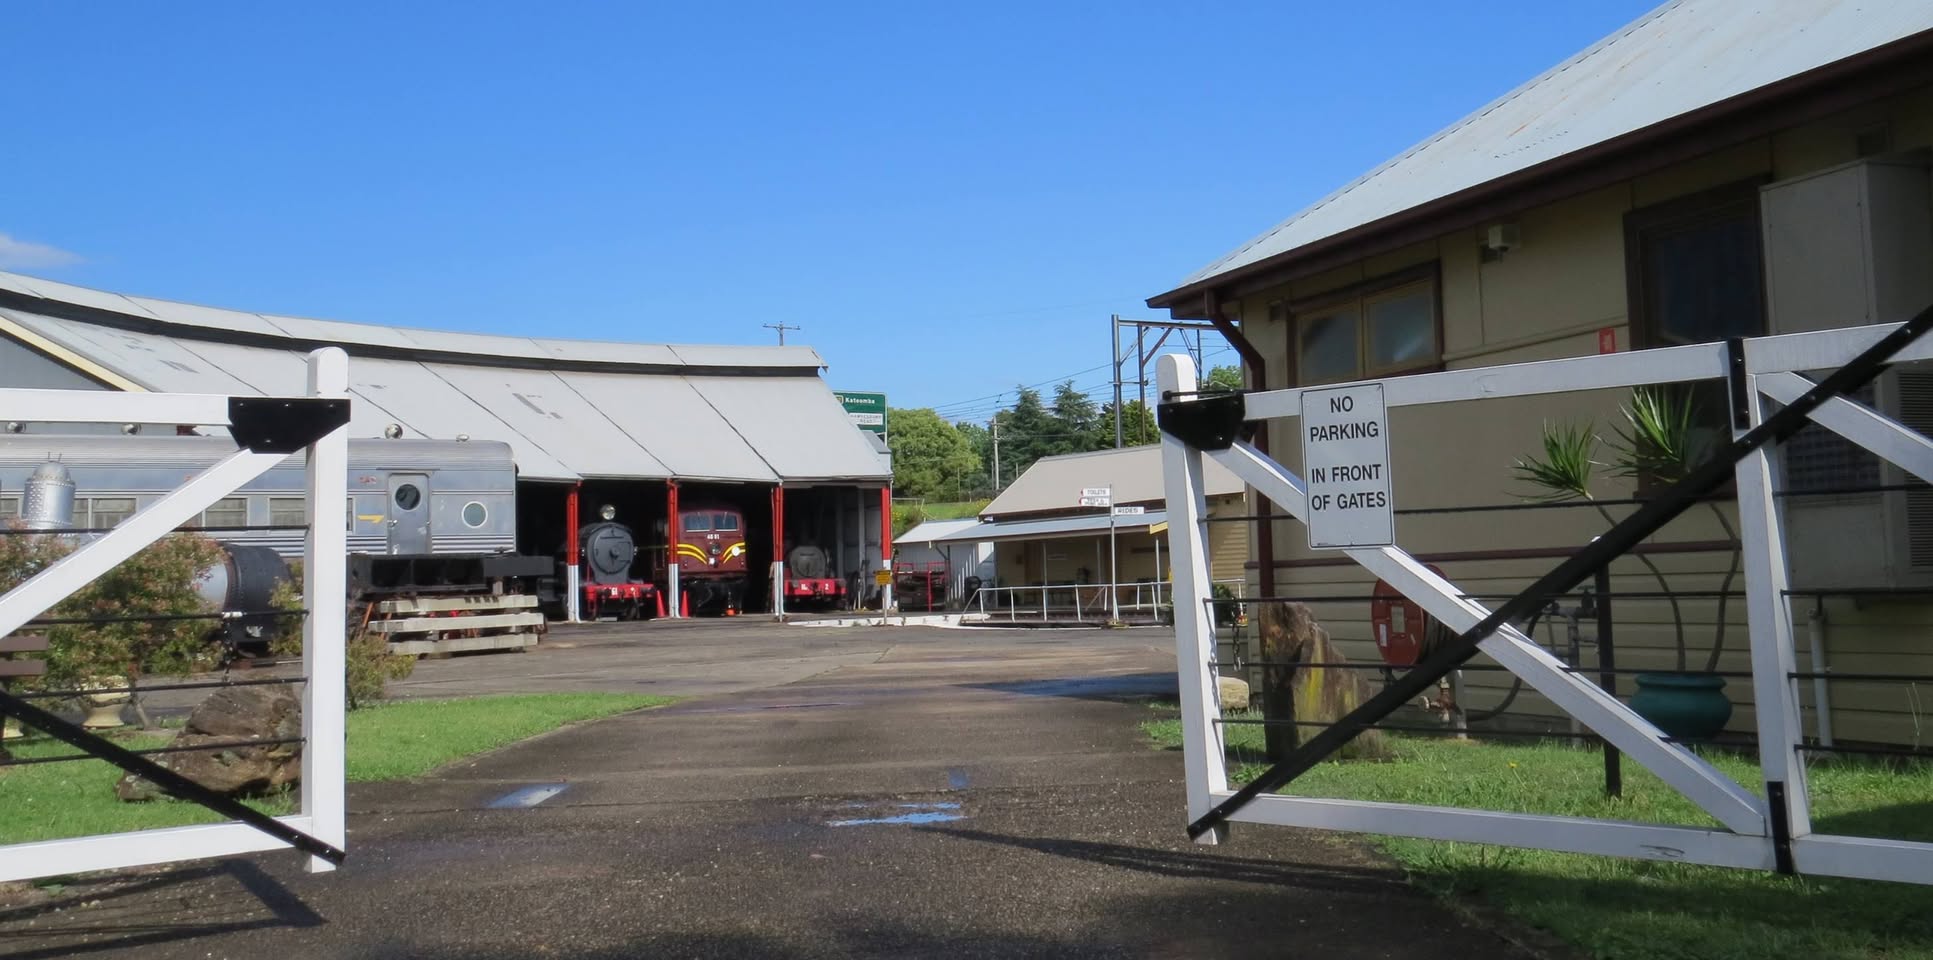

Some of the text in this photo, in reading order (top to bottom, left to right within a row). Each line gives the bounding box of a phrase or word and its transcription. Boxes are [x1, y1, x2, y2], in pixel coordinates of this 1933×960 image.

[1331, 396, 1353, 413] NO
[1311, 421, 1379, 442] PARKING
[1312, 464, 1382, 484] IN FRONT
[1312, 492, 1386, 511] OF GATES
